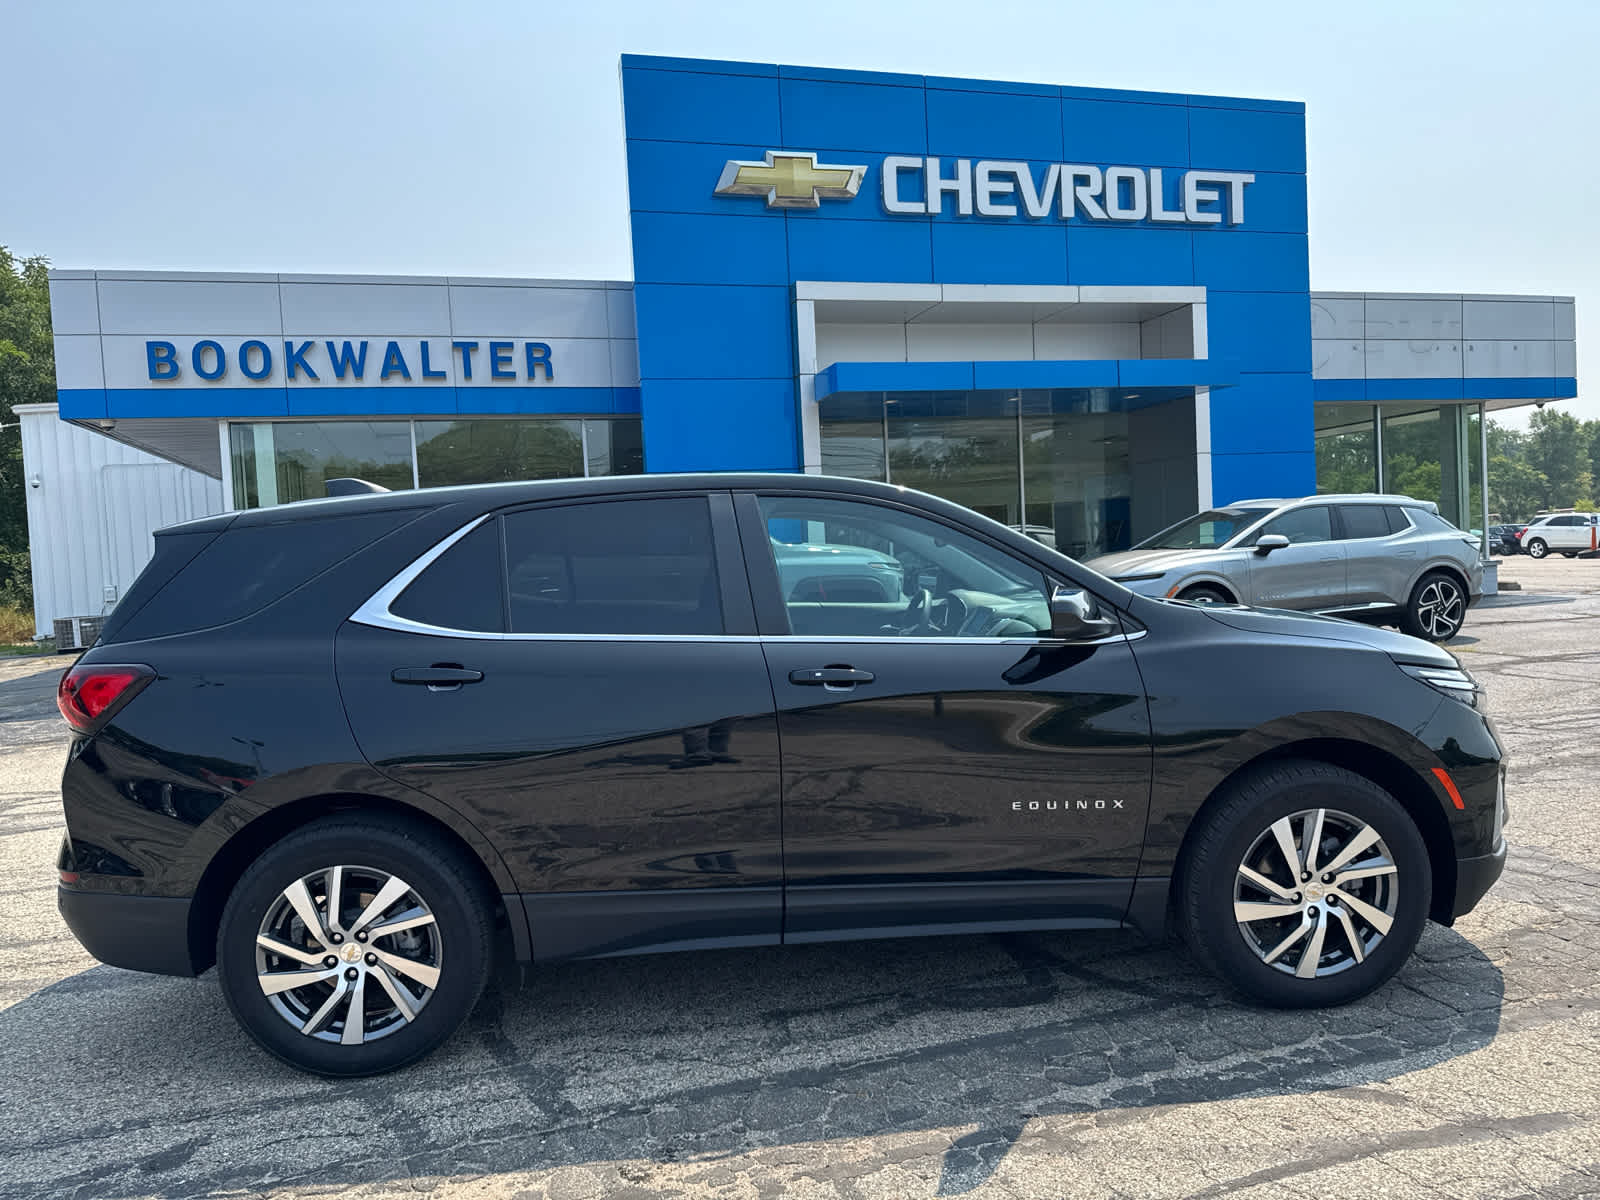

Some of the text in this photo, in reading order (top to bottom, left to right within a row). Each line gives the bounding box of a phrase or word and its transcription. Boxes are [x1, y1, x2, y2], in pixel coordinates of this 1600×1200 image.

[882, 155, 1256, 225] CHEVROLET
[145, 340, 554, 382] BOOKWALTER
[1012, 800, 1124, 811] EQUINOX
